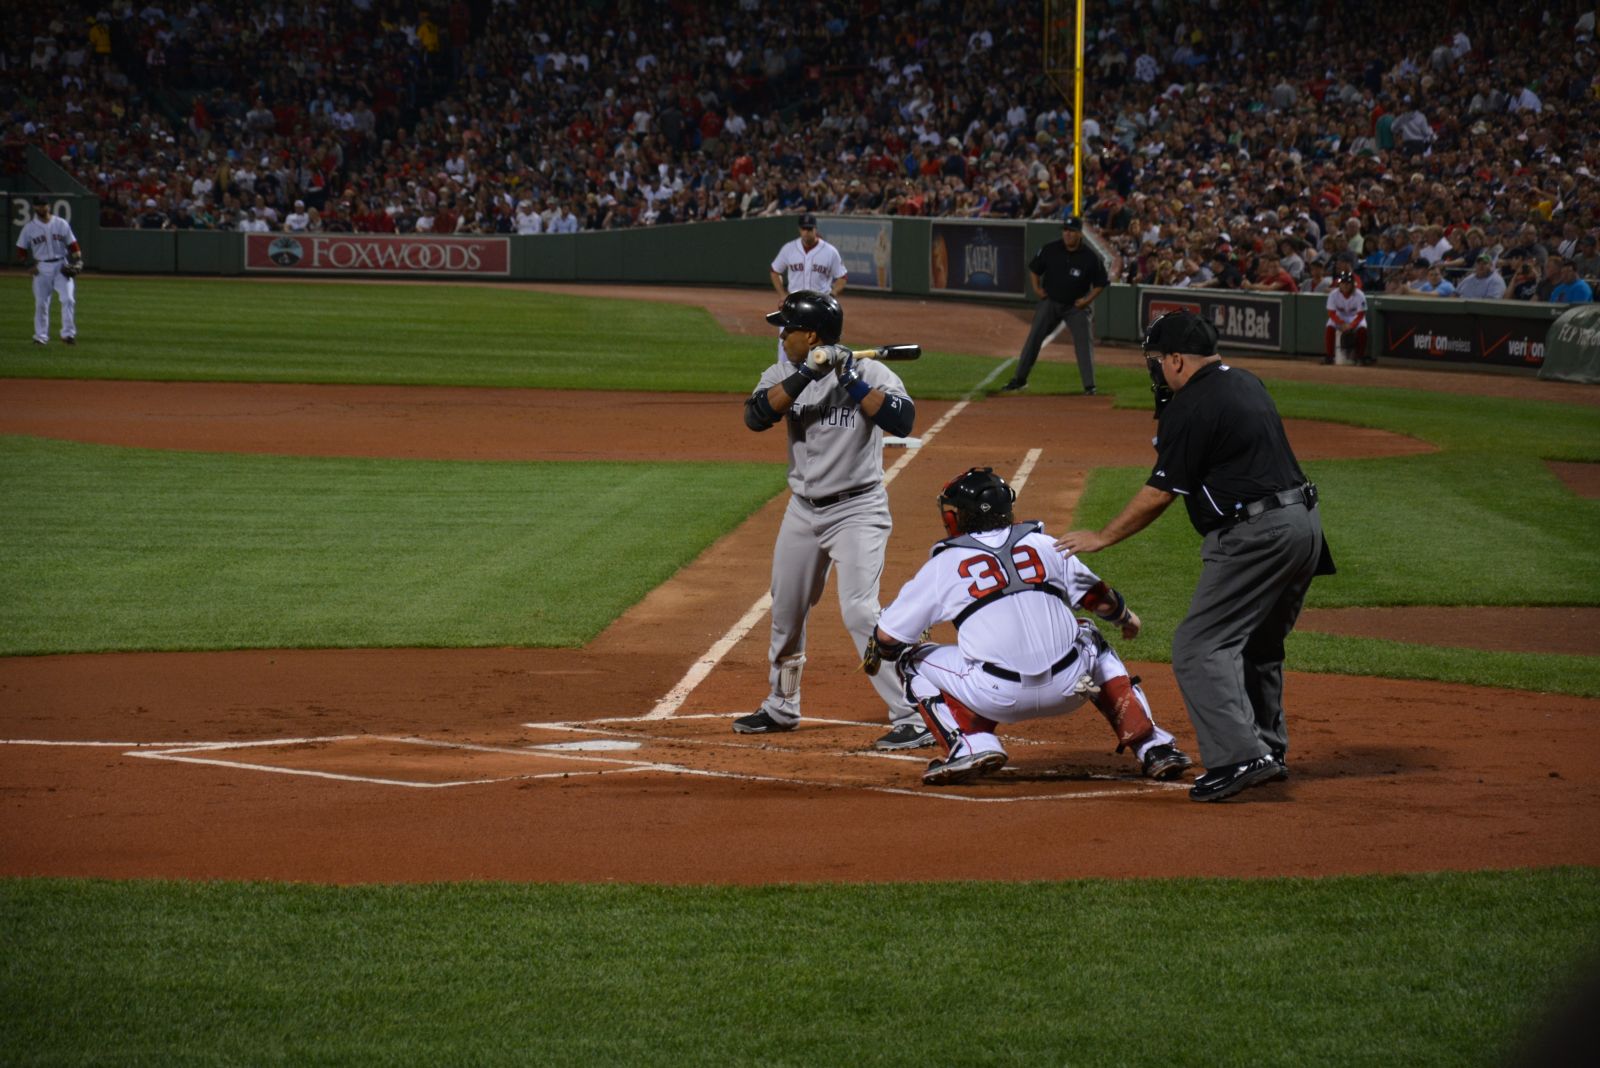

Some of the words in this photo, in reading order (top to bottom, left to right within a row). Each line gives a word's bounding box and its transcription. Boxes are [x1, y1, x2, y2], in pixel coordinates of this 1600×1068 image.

[12, 198, 72, 226] 30
[311, 237, 482, 270] FOXWOODS
[1226, 306, 1243, 338] At
[1245, 307, 1270, 339] Bat
[1413, 330, 1448, 353] verizon
[1508, 336, 1544, 360] verizon
